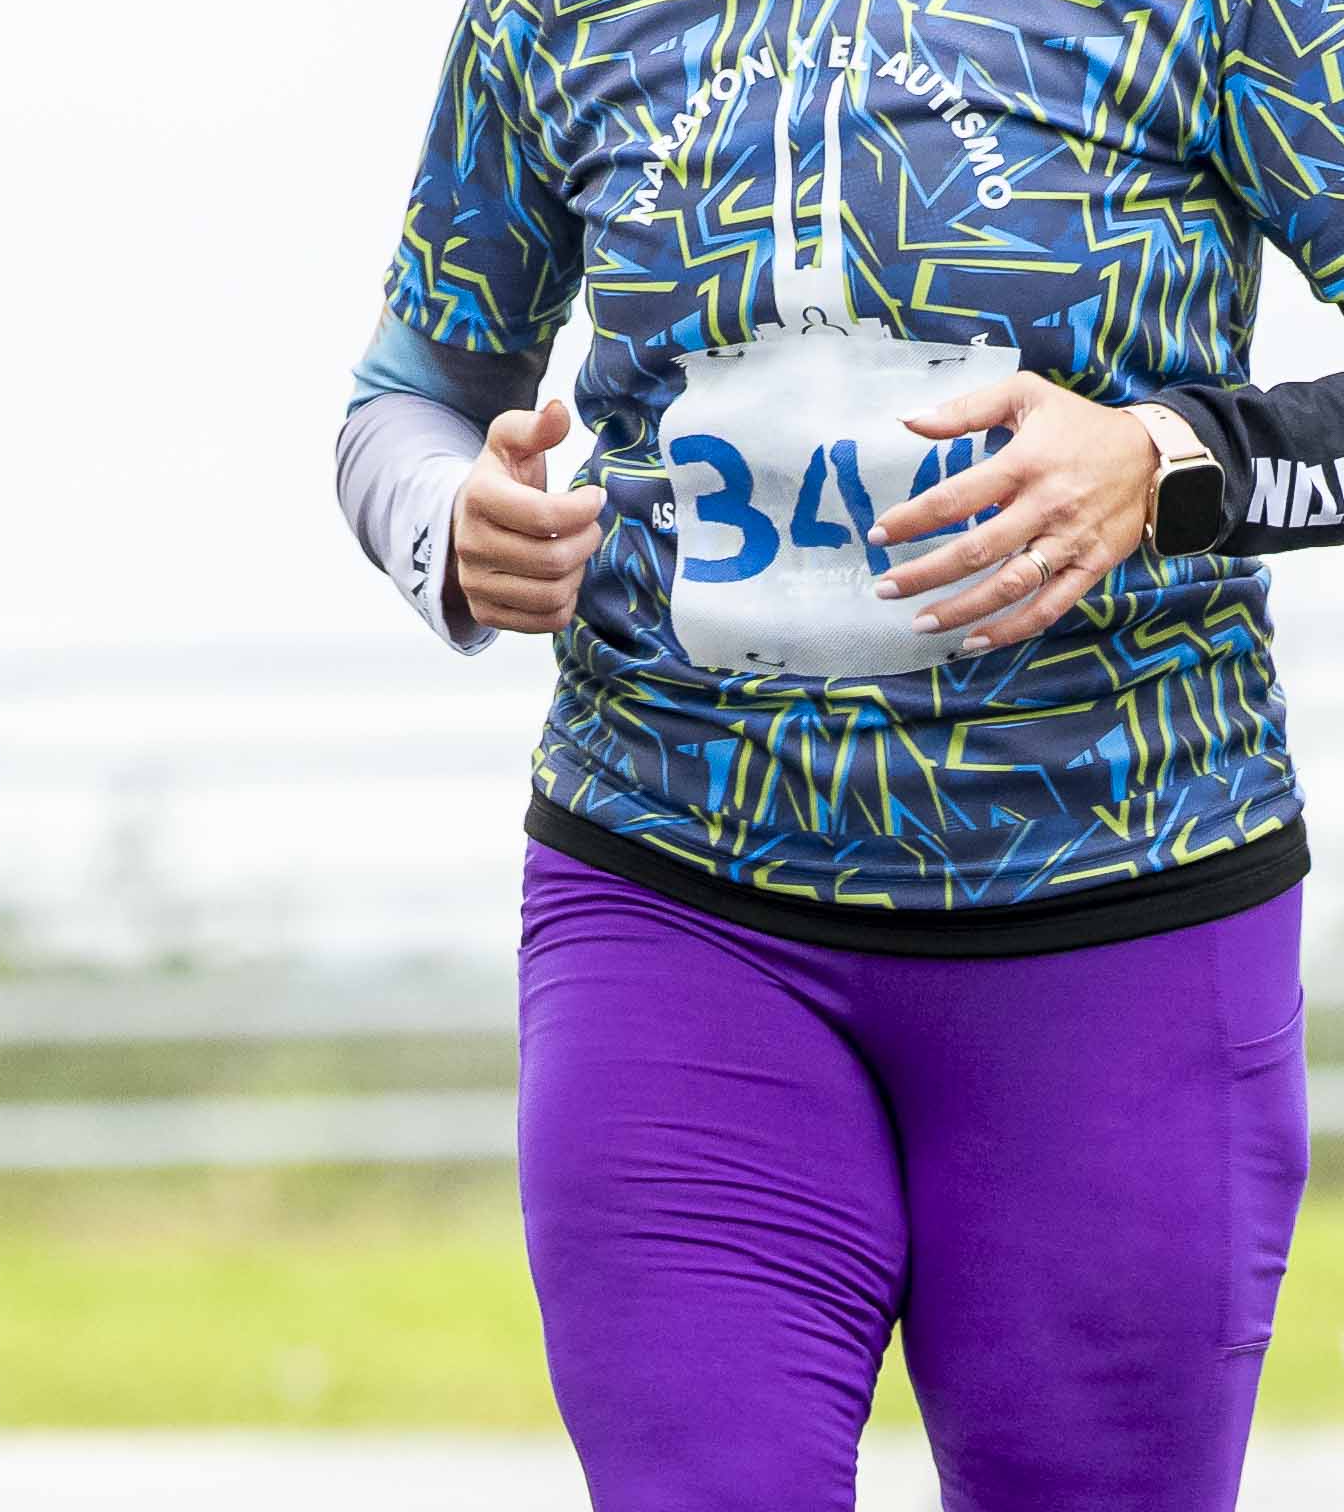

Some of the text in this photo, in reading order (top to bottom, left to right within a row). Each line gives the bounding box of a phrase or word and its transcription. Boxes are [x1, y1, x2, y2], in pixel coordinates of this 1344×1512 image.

[787, 37, 816, 72] X
[828, 36, 870, 72] EL
[876, 51, 1013, 210] AUTISMO
